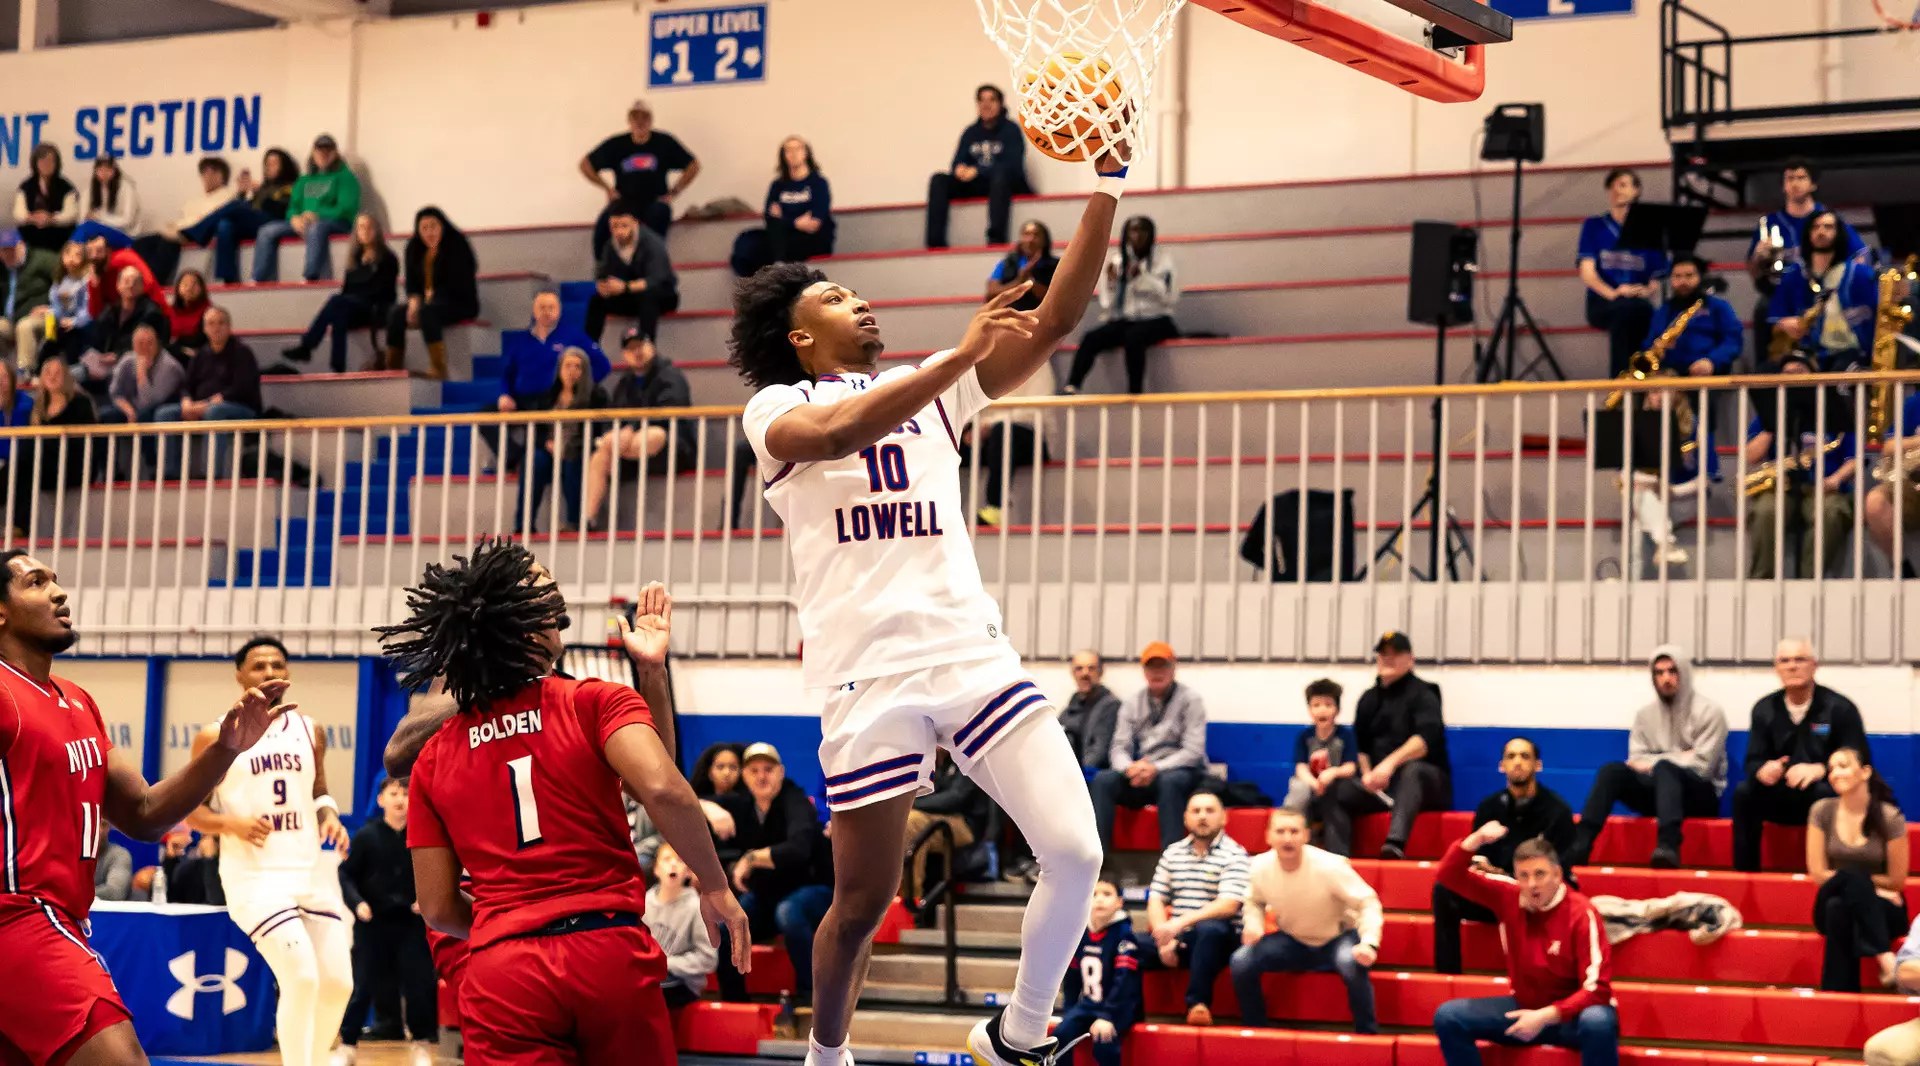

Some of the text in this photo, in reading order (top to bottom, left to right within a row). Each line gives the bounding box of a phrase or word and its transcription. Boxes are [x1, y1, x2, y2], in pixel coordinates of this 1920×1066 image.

[672, 37, 738, 83] 1 2
[74, 94, 261, 160] SECTION
[860, 444, 910, 493] 10
[835, 501, 943, 544] LOWELL
[468, 708, 543, 750] BOLDEN
[64, 737, 103, 782] NJIT
[250, 753, 303, 775] UMASS
[273, 779, 287, 806] 9
[506, 754, 544, 850] 1
